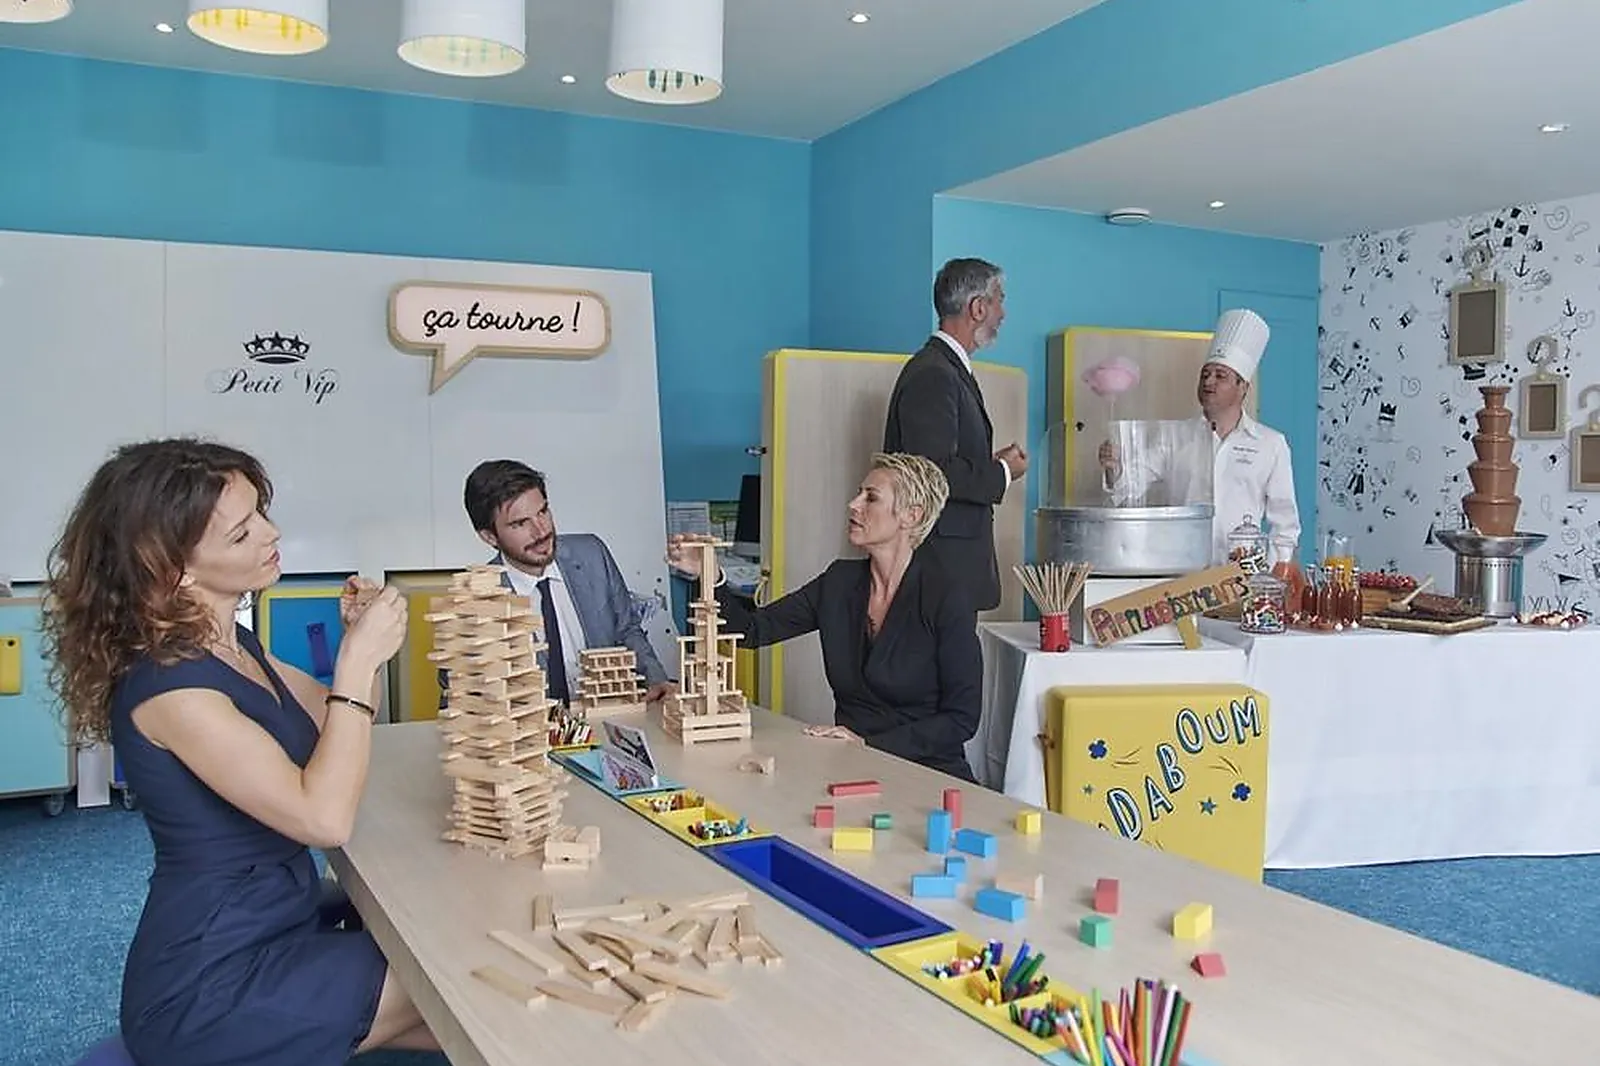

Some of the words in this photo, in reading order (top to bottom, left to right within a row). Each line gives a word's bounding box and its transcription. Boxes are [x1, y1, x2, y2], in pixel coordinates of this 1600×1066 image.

[423, 309, 460, 337] ça
[466, 302, 564, 333] tourne
[209, 368, 282, 394] Petit
[294, 368, 341, 404] Vip
[1098, 696, 1261, 840] DABOUM
